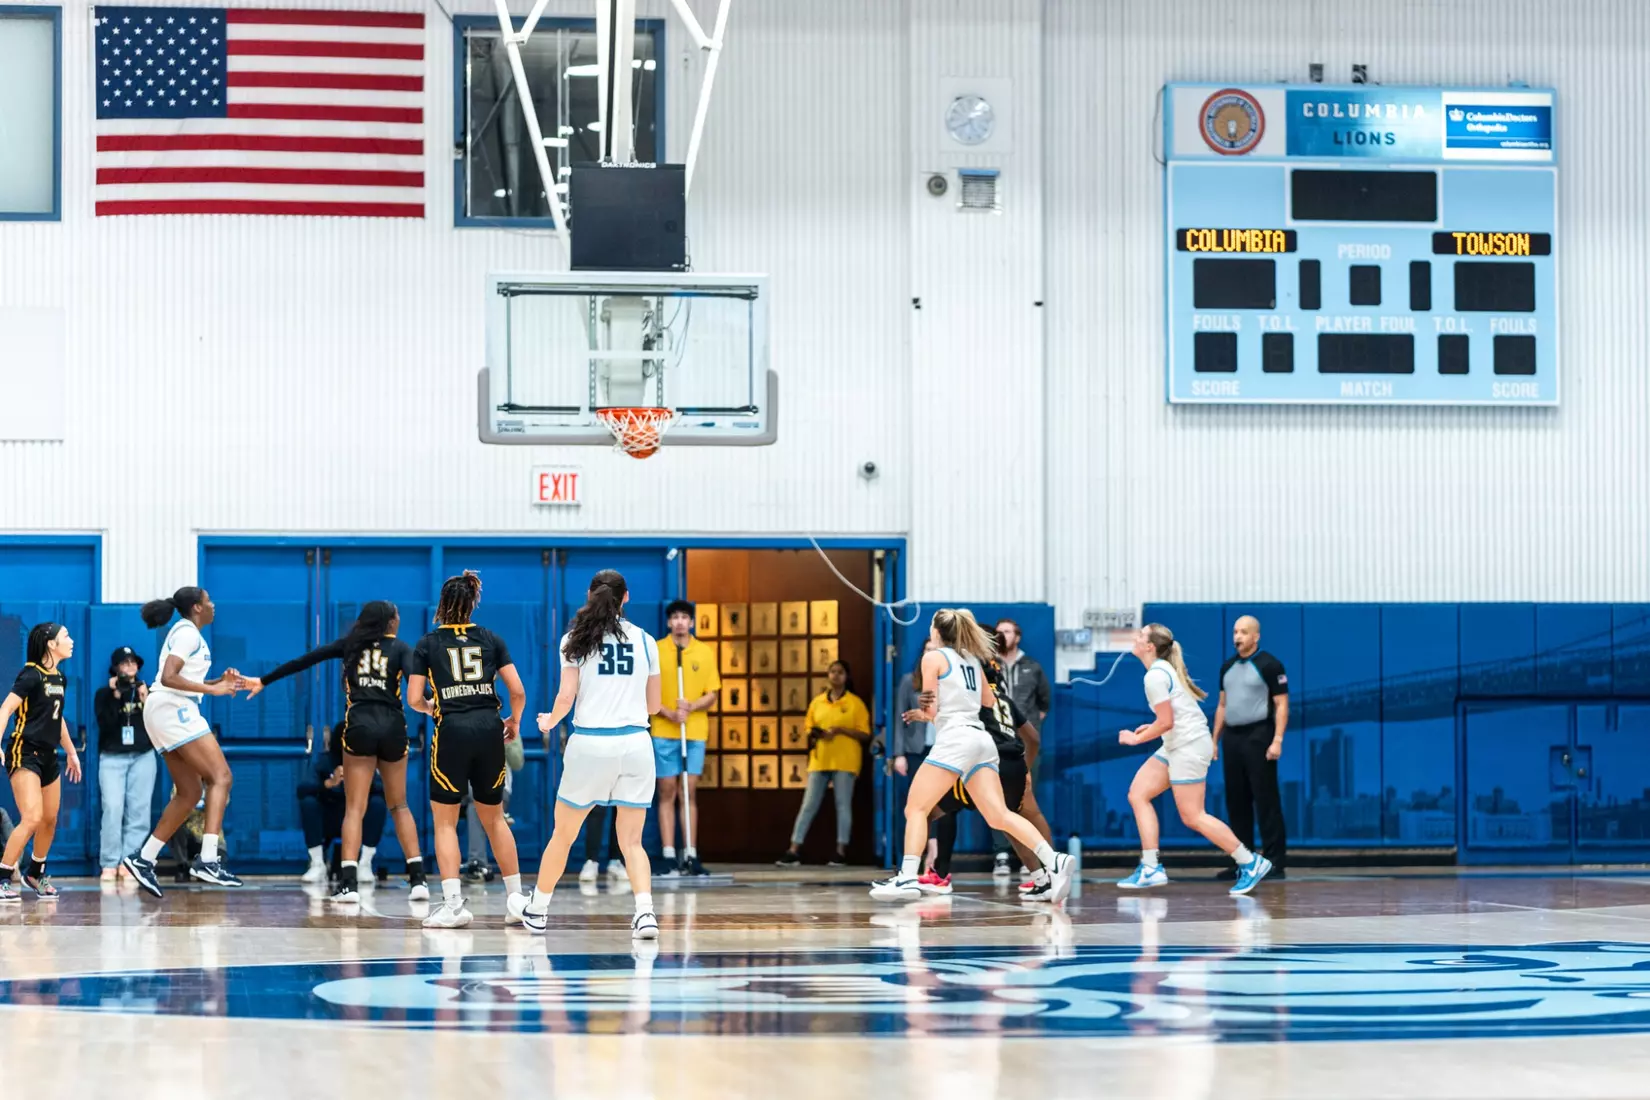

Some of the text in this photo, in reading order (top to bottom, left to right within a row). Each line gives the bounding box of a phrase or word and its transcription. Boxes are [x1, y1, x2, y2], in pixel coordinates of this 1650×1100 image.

[1303, 102, 1425, 119] COLUMBIA
[1333, 131, 1396, 145] LIONS
[601, 161, 657, 169] DAKTRONICS
[1186, 228, 1285, 252] COLUMBIA
[1452, 232, 1530, 256] TOWSON
[1337, 243, 1391, 259] PERIOD
[1193, 314, 1241, 330] FOULS
[1259, 315, 1299, 331] T.O.L.
[1316, 316, 1416, 333] PLAYER FOUL
[1433, 317, 1473, 333] T.O.L.
[1490, 318, 1537, 333] FOULS
[1192, 380, 1240, 396] SCORE
[1341, 381, 1393, 397] MATCH
[1492, 382, 1539, 398] SCORE
[539, 472, 578, 501] EXIT
[446, 646, 484, 682] 15
[598, 642, 634, 675] 35
[960, 664, 977, 692] 10
[52, 699, 61, 720] 2
[177, 707, 189, 724] C
